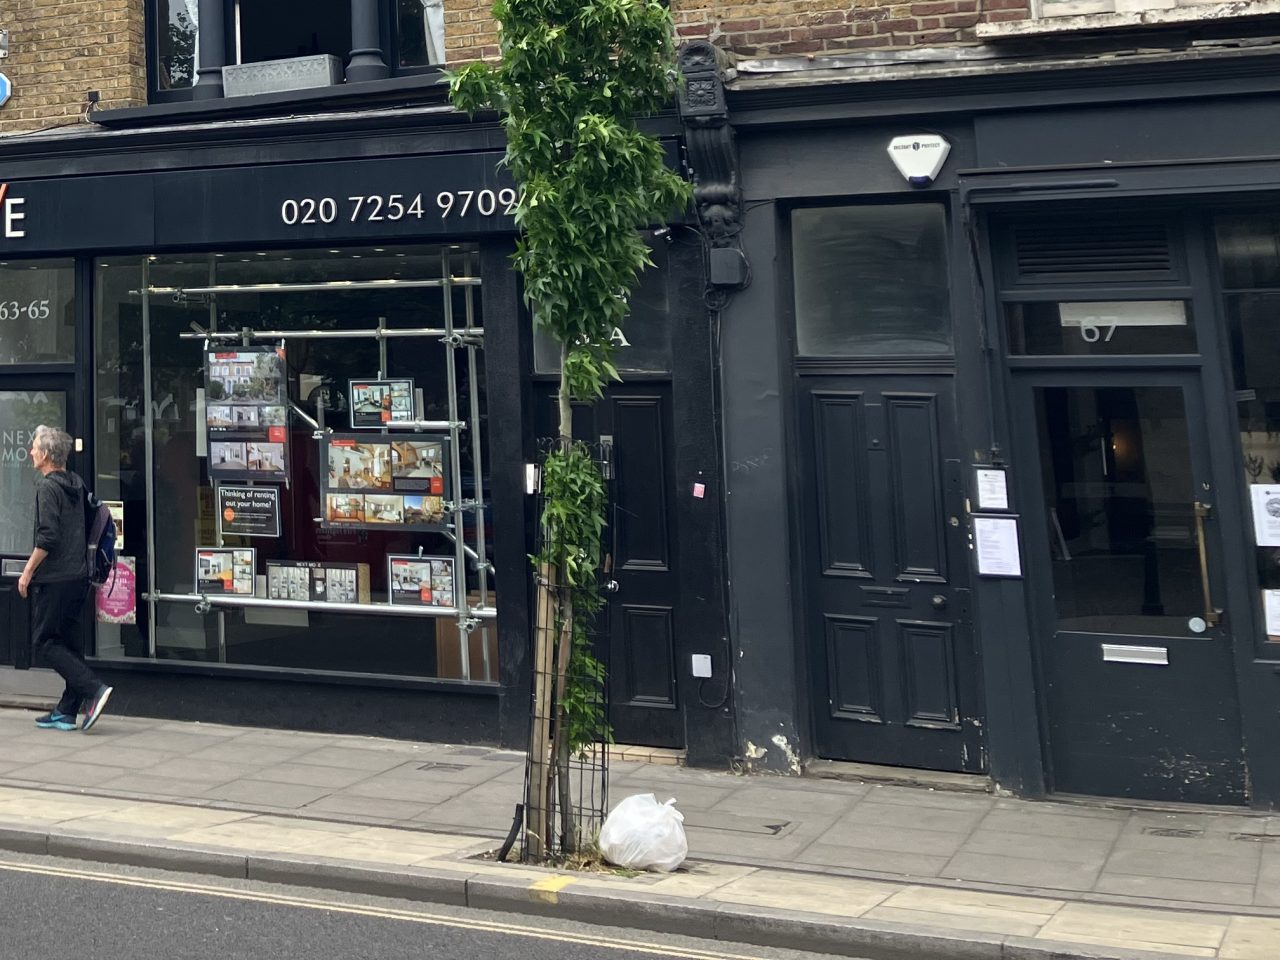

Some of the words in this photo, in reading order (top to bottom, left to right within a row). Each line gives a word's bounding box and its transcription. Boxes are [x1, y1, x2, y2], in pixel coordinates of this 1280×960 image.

[281, 197, 339, 225] 020
[348, 193, 426, 222] 7254
[436, 188, 518, 218] 9709
[1081, 316, 1119, 343] 67
[2, 430, 37, 446] NEX
[1, 446, 28, 462] MO
[221, 489, 246, 500] Thinking
[254, 492, 275, 501] renting
